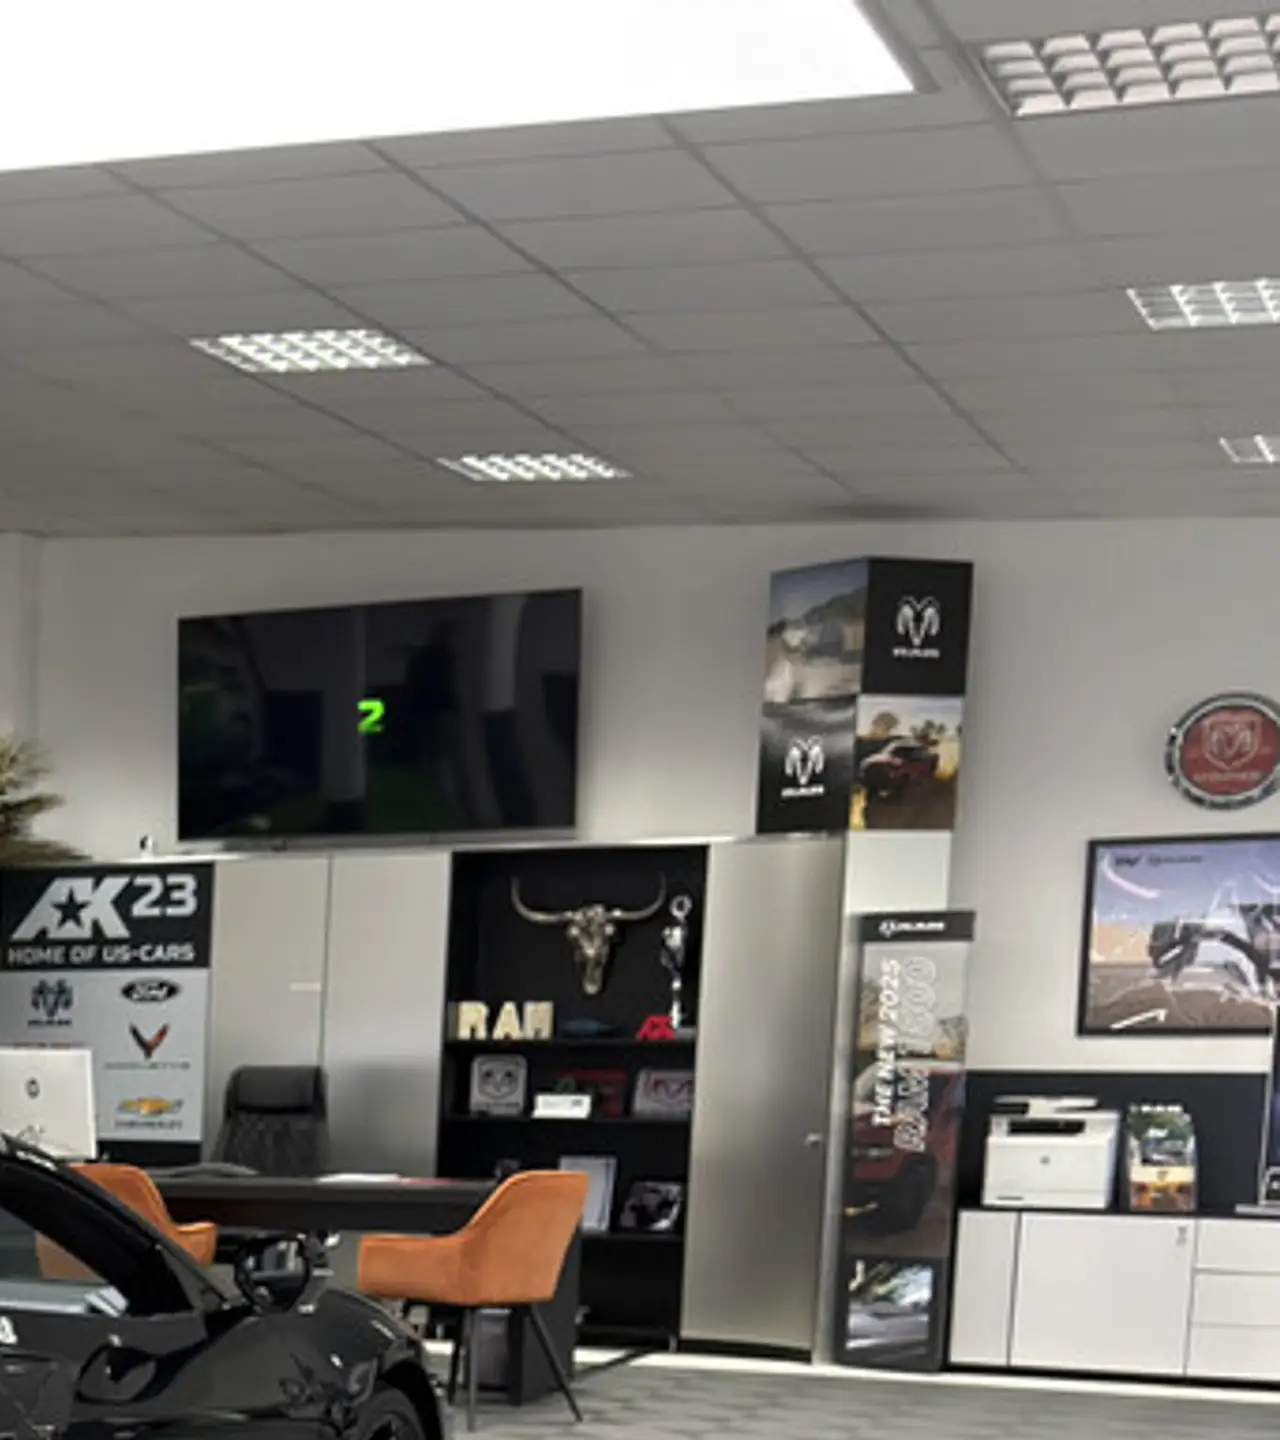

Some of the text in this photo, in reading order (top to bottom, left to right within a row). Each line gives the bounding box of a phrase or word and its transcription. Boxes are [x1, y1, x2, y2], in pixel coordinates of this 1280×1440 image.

[356, 698, 385, 733] 2
[8, 943, 195, 965] HOME OF US-CARS
